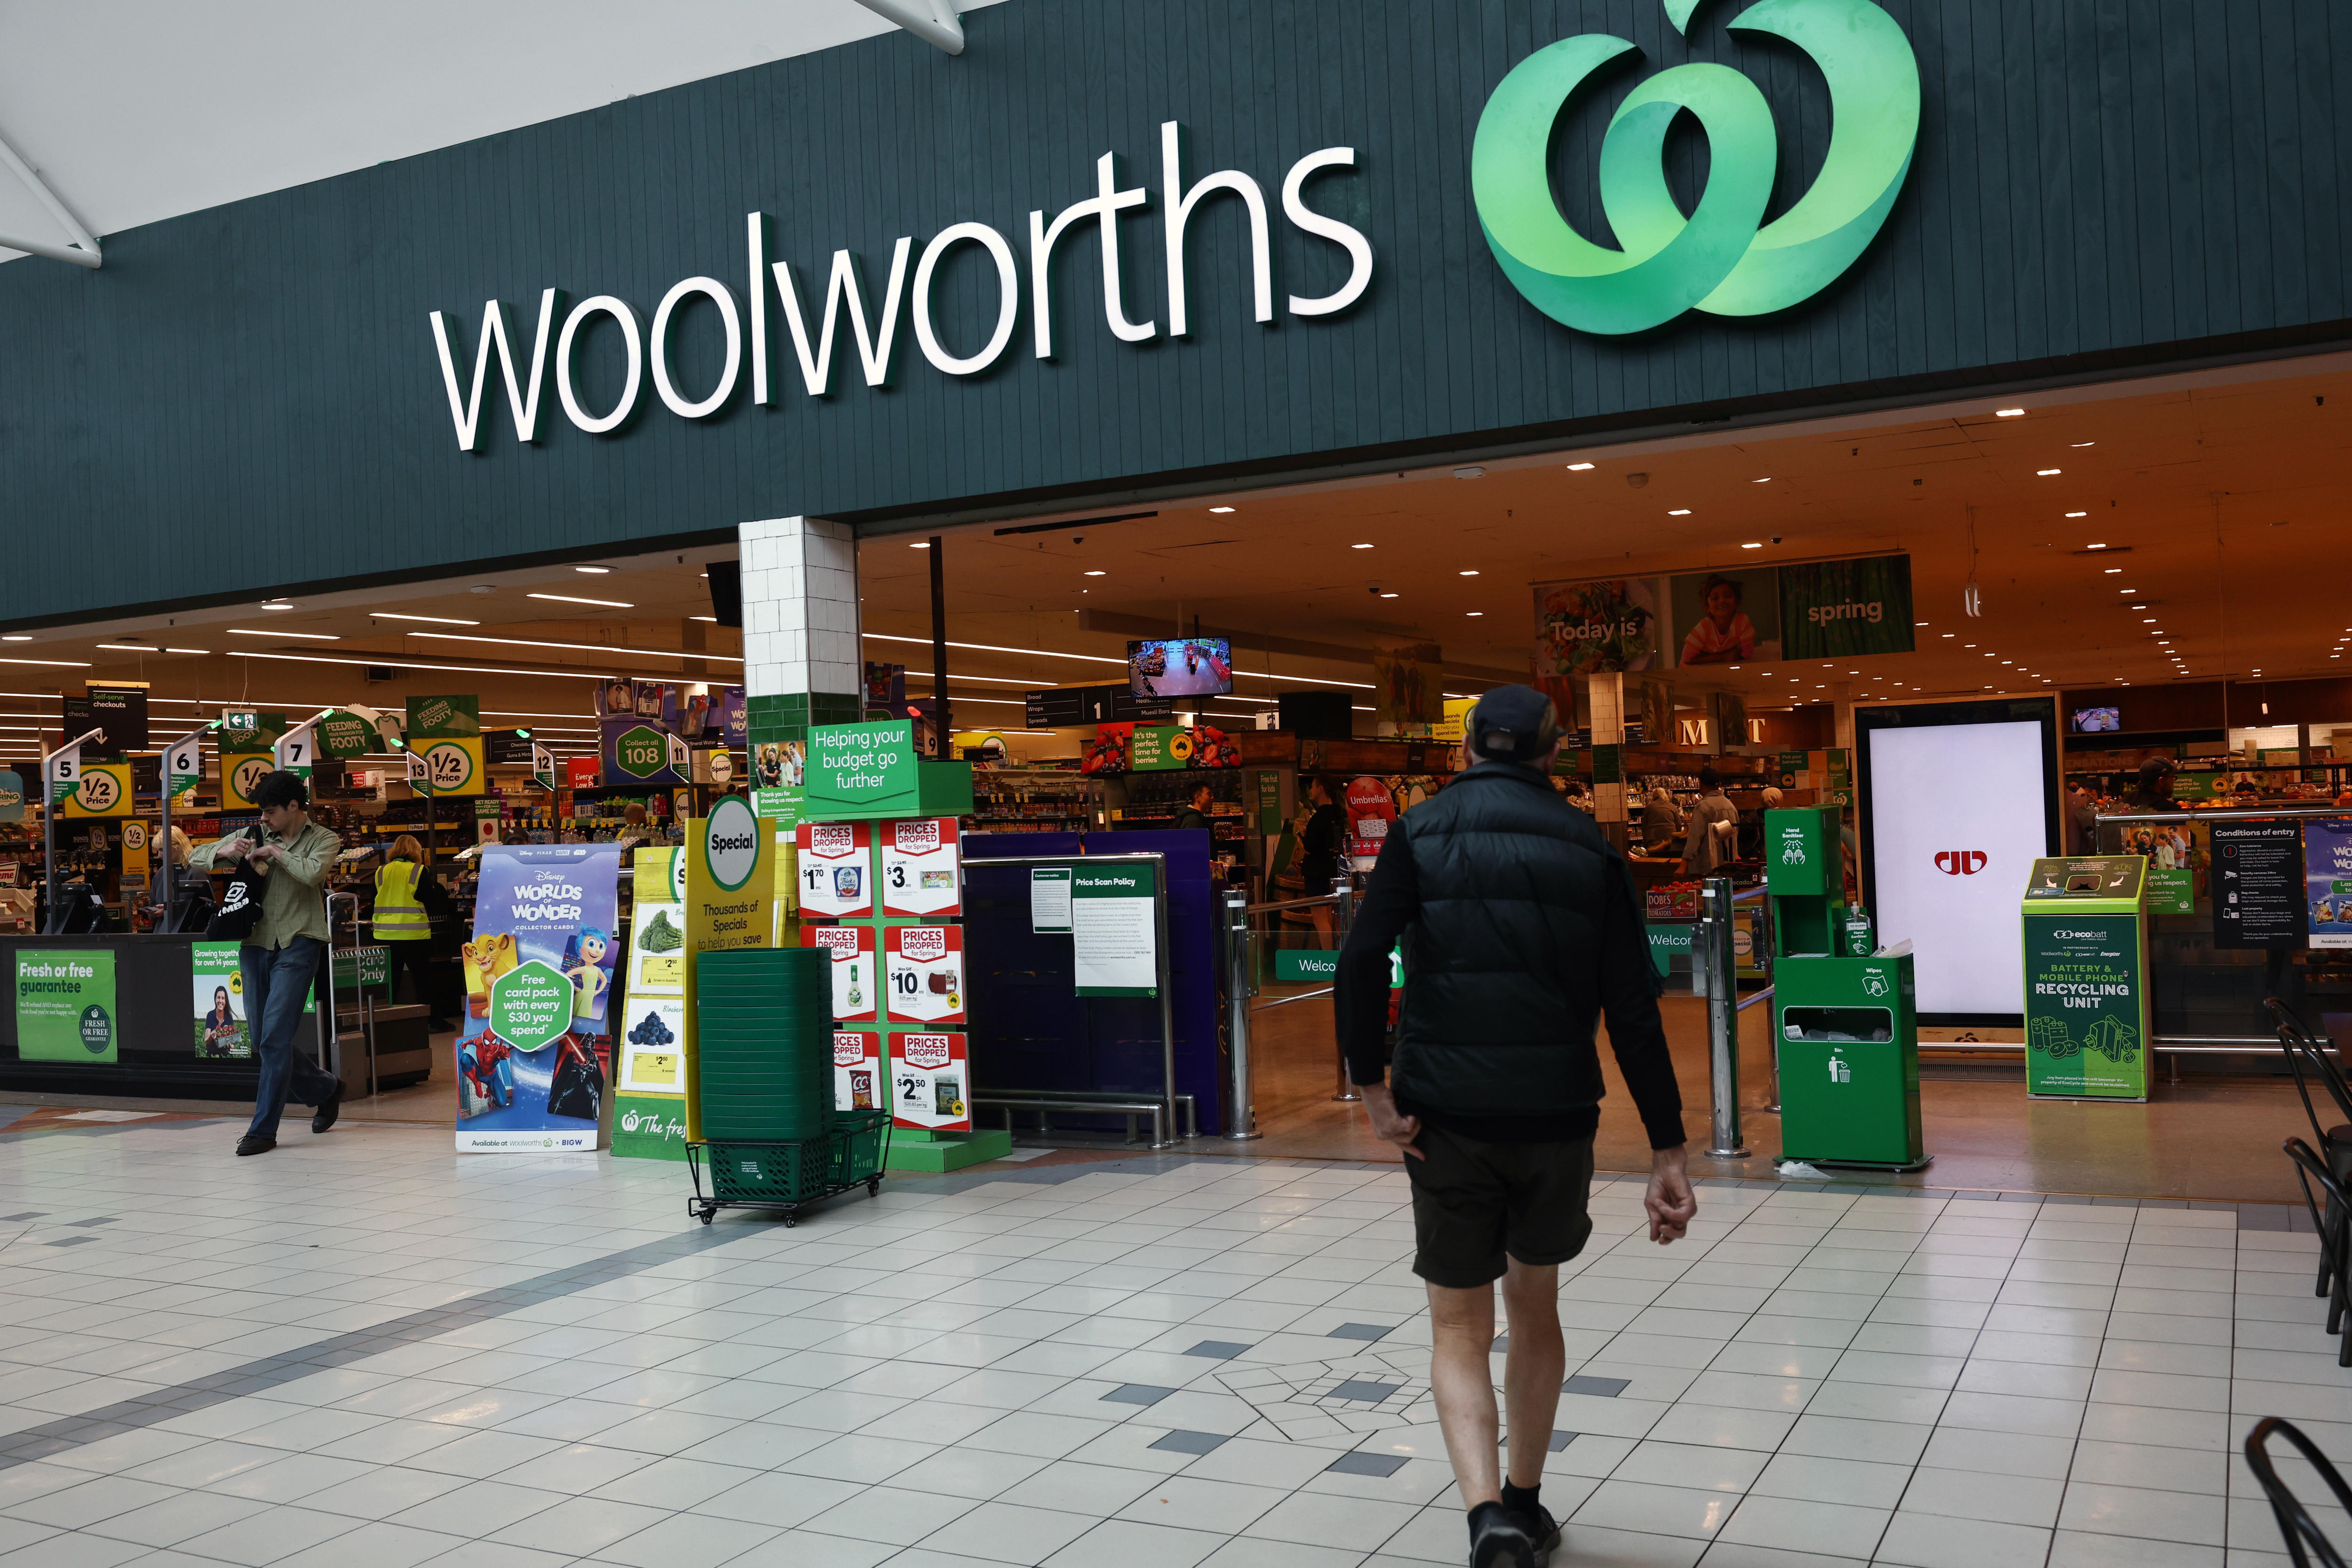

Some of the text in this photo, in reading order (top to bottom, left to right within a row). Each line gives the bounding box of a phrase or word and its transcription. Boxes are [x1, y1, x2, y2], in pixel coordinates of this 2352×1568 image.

[1808, 600, 1883, 627] spring
[1550, 617, 1637, 644] Today is
[1094, 702, 1101, 719] 1
[325, 720, 362, 731] FEEDING
[330, 736, 366, 749] FOOTY
[816, 730, 905, 750] Helping your
[929, 737, 936, 751] 9
[291, 745, 302, 762] 7
[626, 748, 659, 764] 108
[675, 747, 683, 760] 11
[177, 754, 189, 770] 6
[432, 753, 461, 772] 1/2
[537, 756, 550, 769] 12
[823, 751, 897, 771] budget go
[60, 762, 72, 777] 5
[412, 764, 424, 776] 13
[84, 778, 110, 796] 1/2
[836, 772, 885, 788] further
[1350, 795, 1387, 804] Umbrellas
[129, 829, 140, 839] 1/2
[814, 828, 850, 838] PRICES
[898, 824, 937, 834] PRICES
[712, 833, 753, 854] Special
[887, 867, 905, 887] $3
[1114, 878, 1136, 887] Policy
[514, 883, 582, 901] WORLDS
[1649, 894, 1671, 906] DOBES
[512, 904, 581, 921] WONDER
[703, 900, 758, 916] Thousands of
[713, 918, 747, 934] Specials
[698, 934, 761, 950] to help you save
[818, 931, 855, 940] PRICES
[904, 931, 942, 940] PRICES
[194, 950, 217, 958] Growing
[20, 963, 93, 977] Fresh or free
[522, 975, 545, 984] Free
[891, 972, 917, 994] $10
[20, 980, 81, 996] guarantee
[505, 988, 559, 999] card pack
[2036, 984, 2129, 995] RECYCLING
[504, 1001, 559, 1011] with every
[2064, 997, 2101, 1008] UNIT
[509, 1013, 553, 1024] $30 you
[907, 1038, 946, 1048] PRICES
[640, 1114, 663, 1133] The
